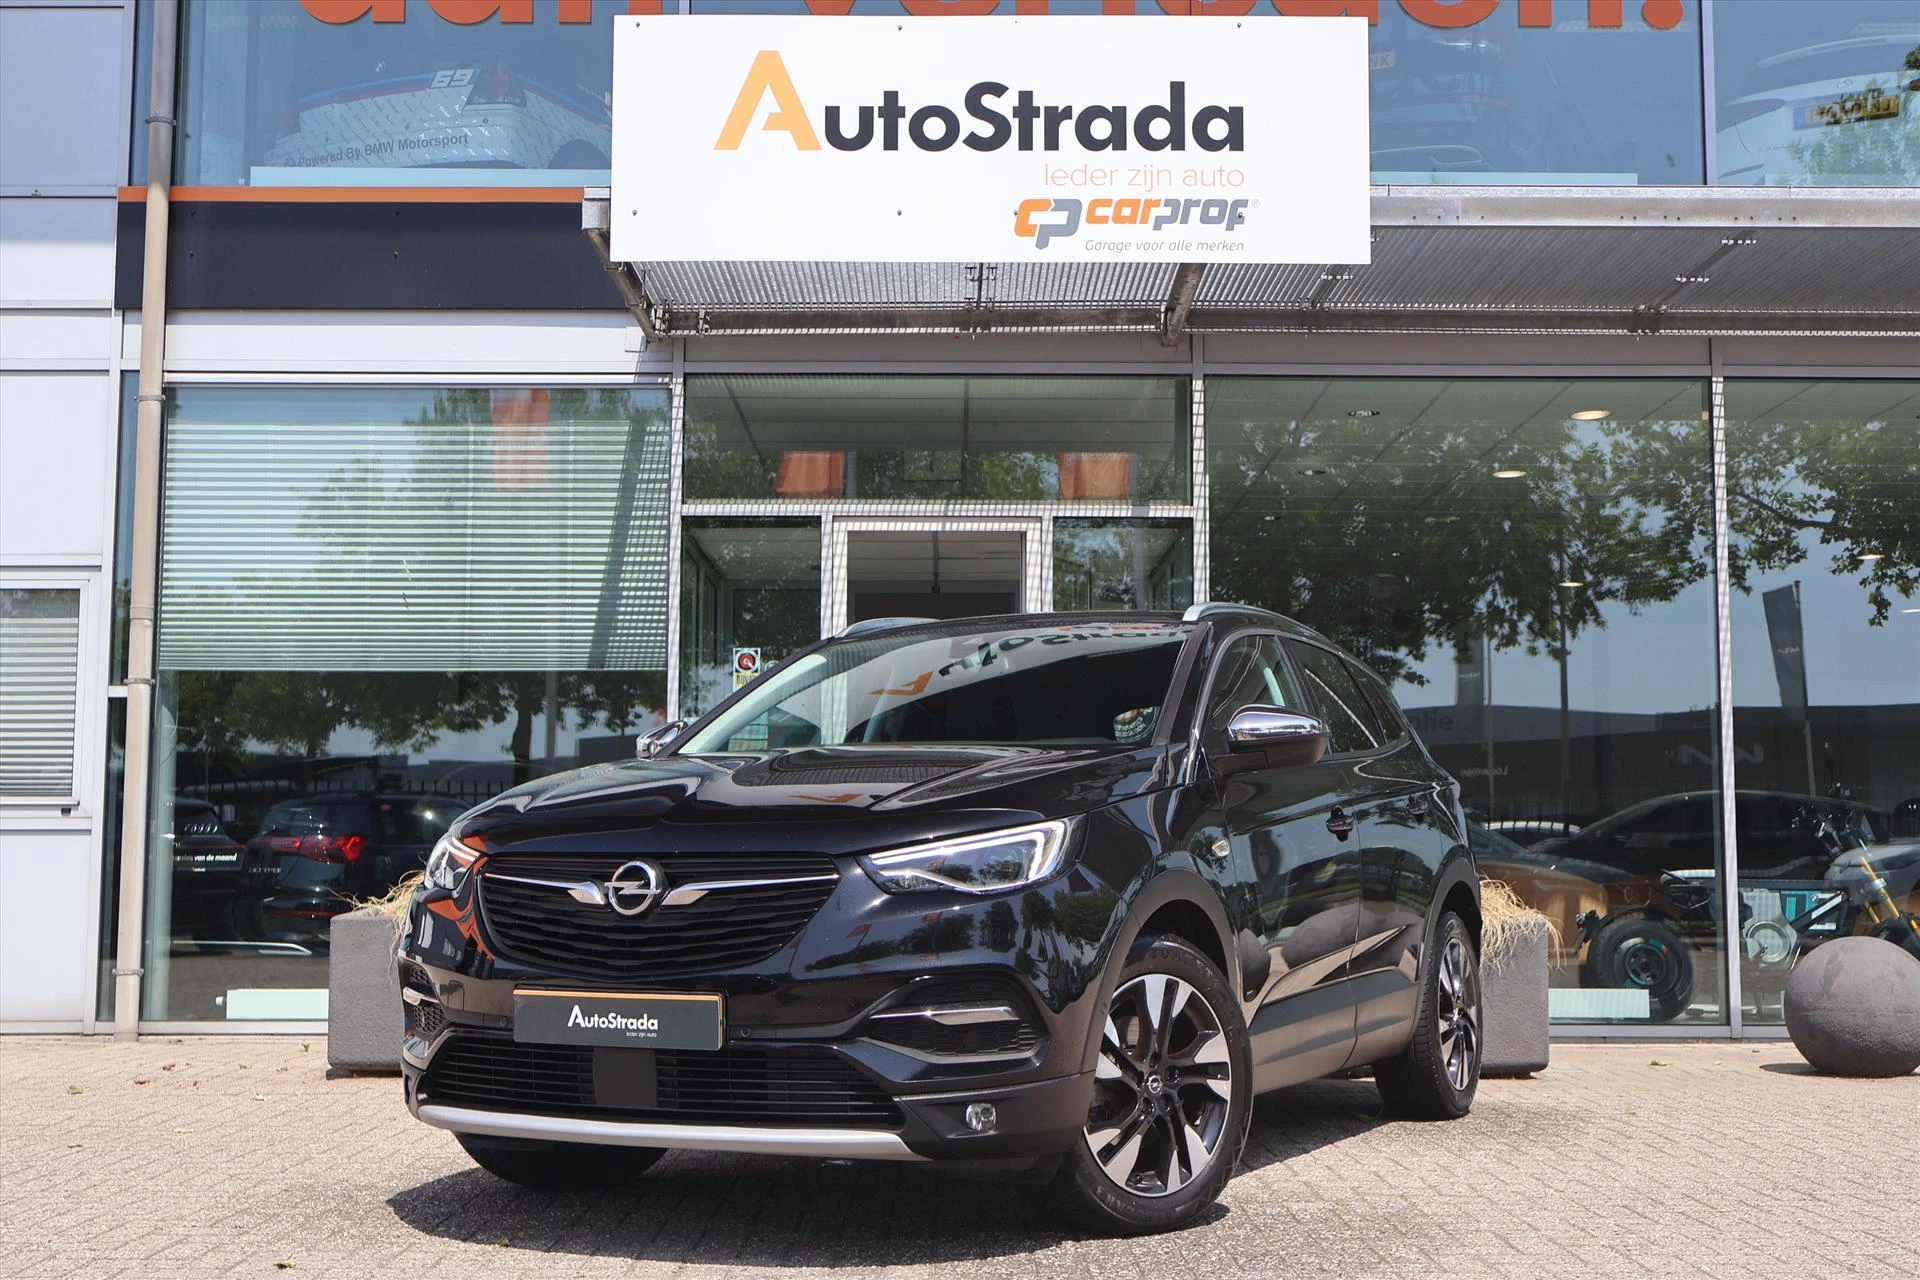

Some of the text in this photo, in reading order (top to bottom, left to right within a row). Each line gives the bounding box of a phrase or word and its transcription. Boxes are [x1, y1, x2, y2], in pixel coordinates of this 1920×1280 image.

[431, 69, 473, 88] 69
[714, 50, 1244, 152] AutoStrada
[298, 132, 469, 166] Powered By BMW Motorsport
[1045, 164, 1245, 192] Ieder zijn auto
[1085, 239, 1245, 254] Garage voor alle merken
[567, 1004, 659, 1031] AutoStrada
